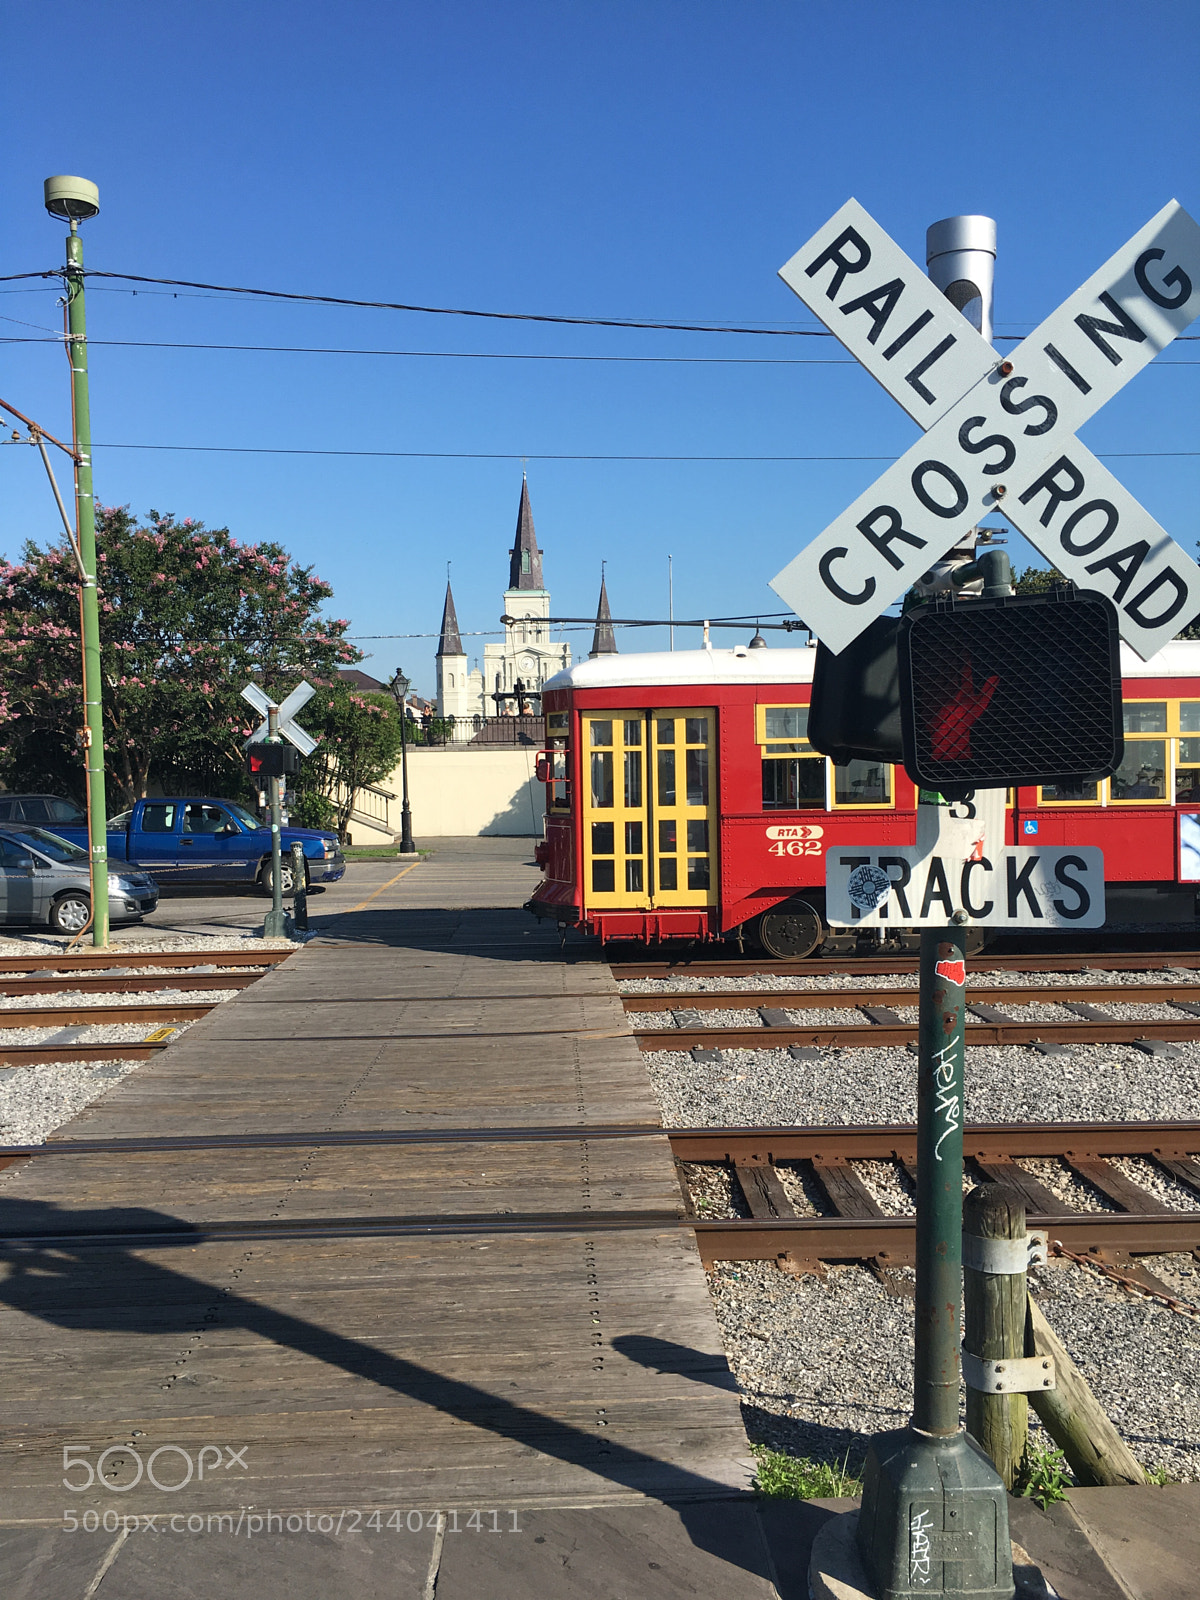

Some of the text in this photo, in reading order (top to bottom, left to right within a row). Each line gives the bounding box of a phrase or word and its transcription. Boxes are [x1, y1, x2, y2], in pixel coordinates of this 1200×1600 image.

[805, 225, 957, 405] RAIL
[818, 248, 1192, 605] CROSSING
[1018, 455, 1188, 629] ROAD
[92, 845, 106, 853] L23
[768, 840, 822, 857] 462
[777, 828, 798, 837] RTA
[840, 855, 1089, 920] TRACKS
